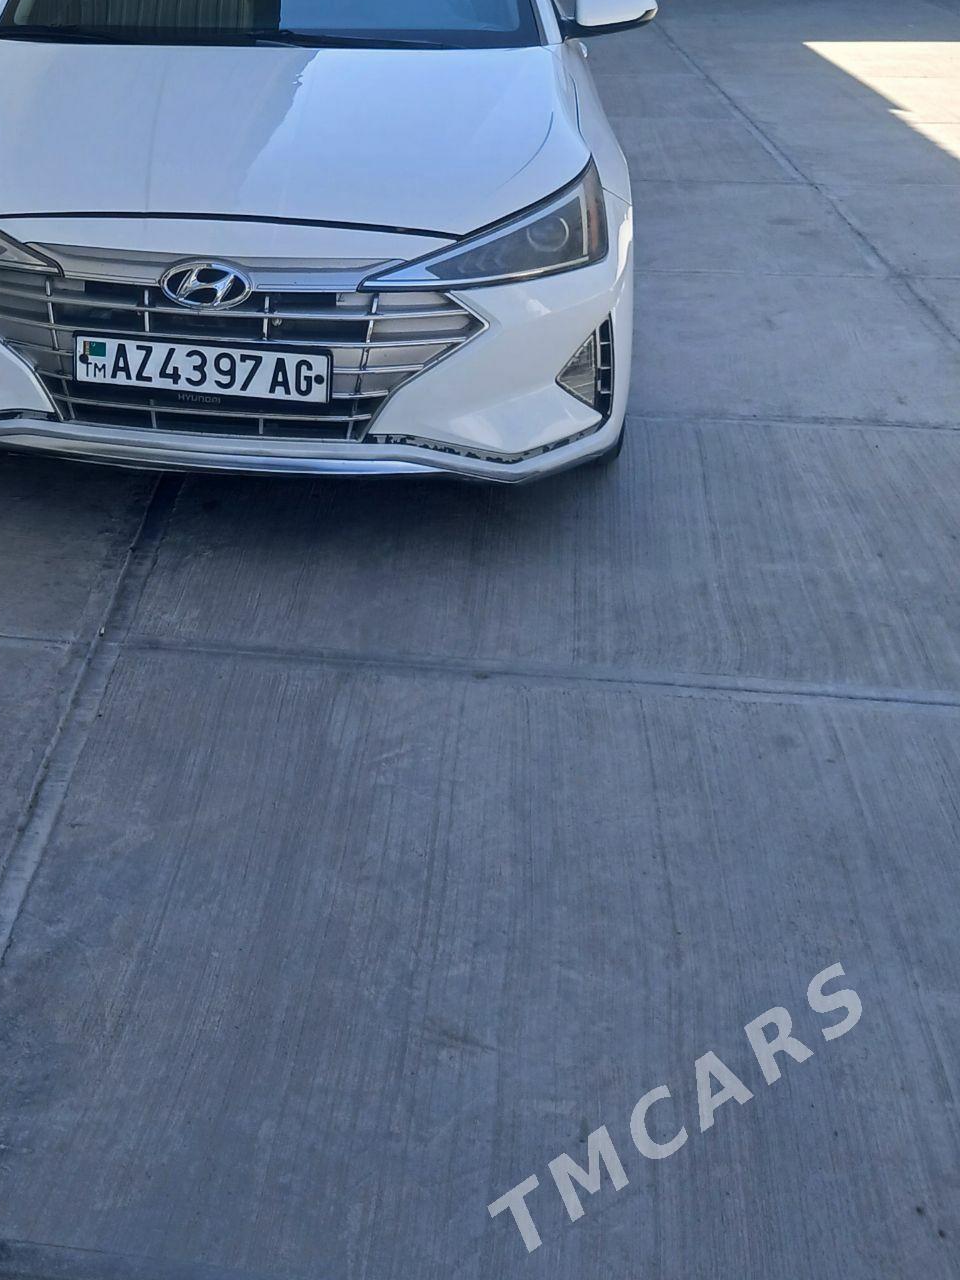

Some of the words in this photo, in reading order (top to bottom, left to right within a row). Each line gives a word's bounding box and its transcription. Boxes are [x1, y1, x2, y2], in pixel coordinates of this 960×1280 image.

[86, 361, 107, 379] TM
[110, 342, 314, 397] AZ4397AG
[177, 393, 222, 405] HYUNDAI
